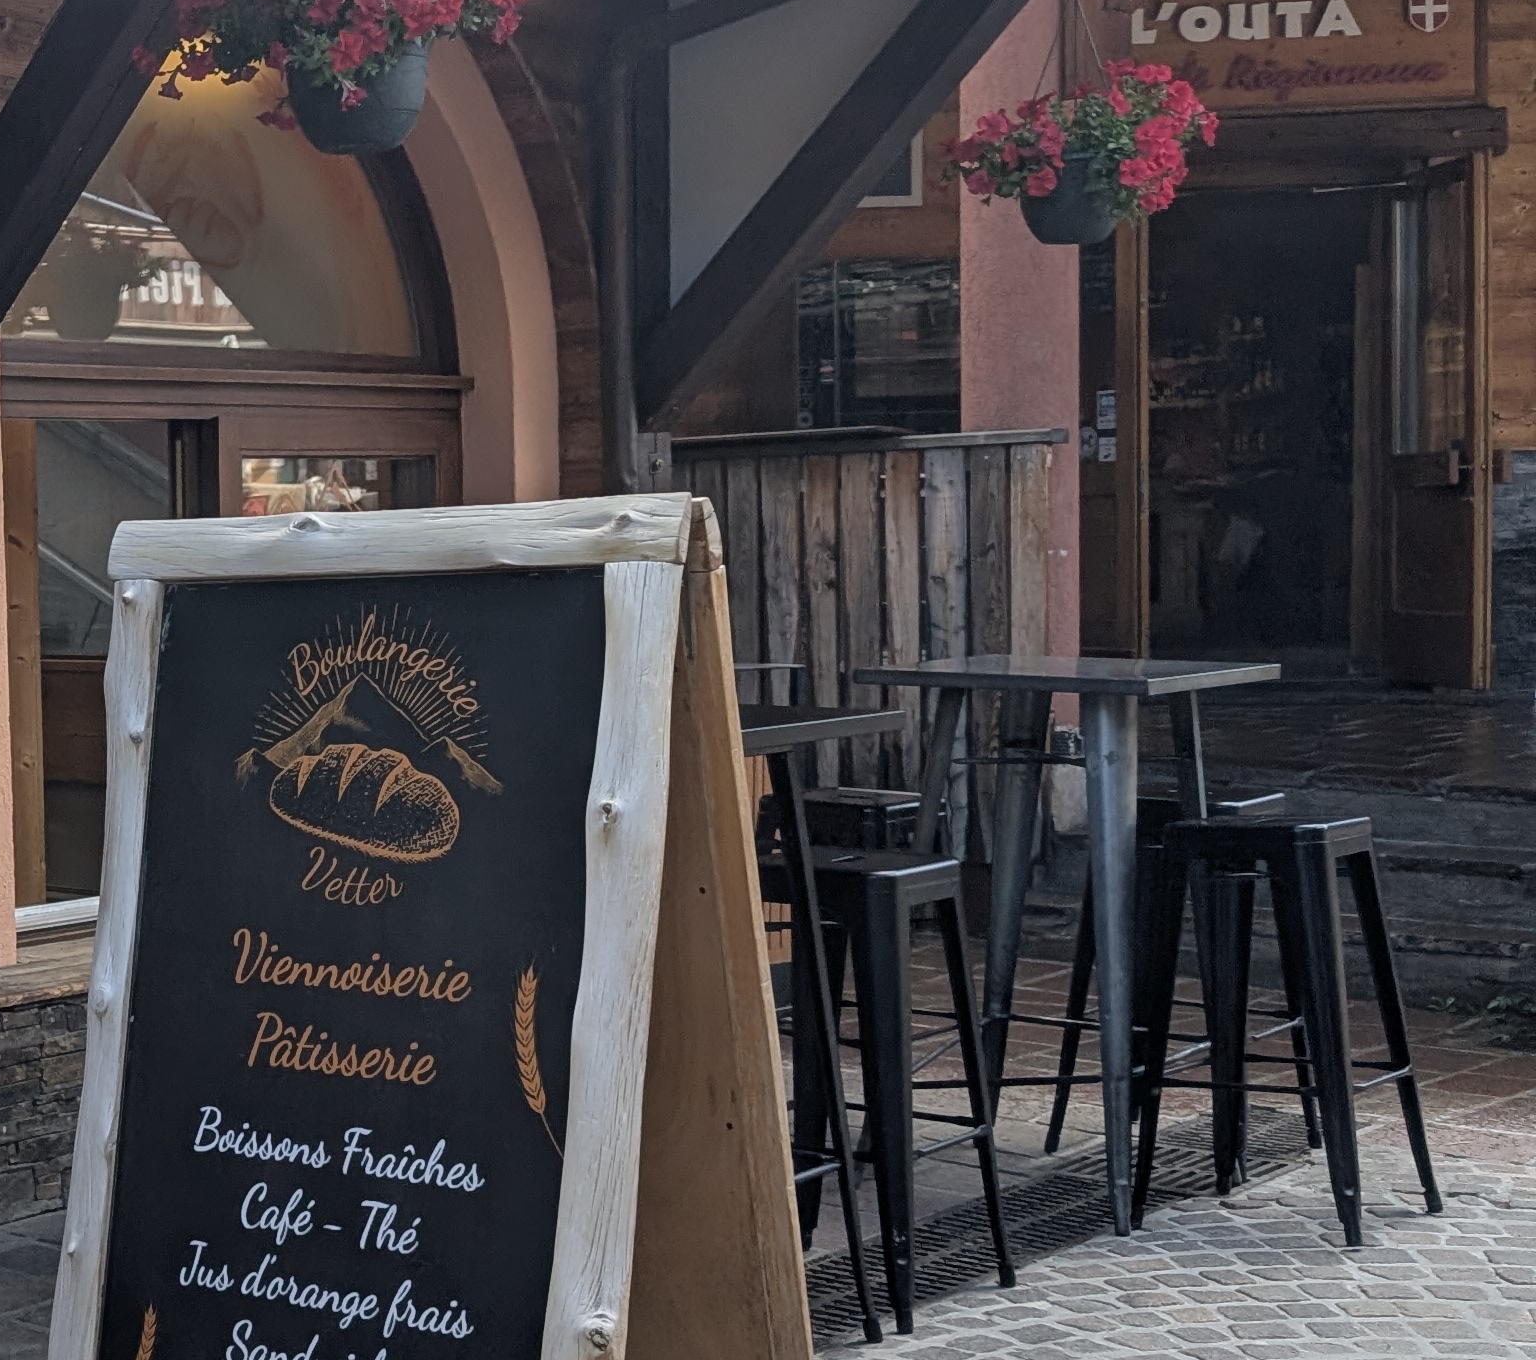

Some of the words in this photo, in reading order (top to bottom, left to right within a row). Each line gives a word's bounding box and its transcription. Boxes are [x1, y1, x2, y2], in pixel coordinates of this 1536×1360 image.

[287, 613, 481, 719] Boulangerie
[301, 846, 404, 906] Vetter
[233, 928, 472, 1003] Viennoiserie
[247, 1012, 437, 1085] Pâtisserie
[194, 1105, 331, 1169] Boissons
[342, 1127, 485, 1192] Fraîches
[240, 1181, 315, 1245] Café
[359, 1200, 422, 1254] Thé
[179, 1240, 235, 1290] Jus
[241, 1253, 379, 1329] d'orange
[383, 1279, 475, 1338] frais
